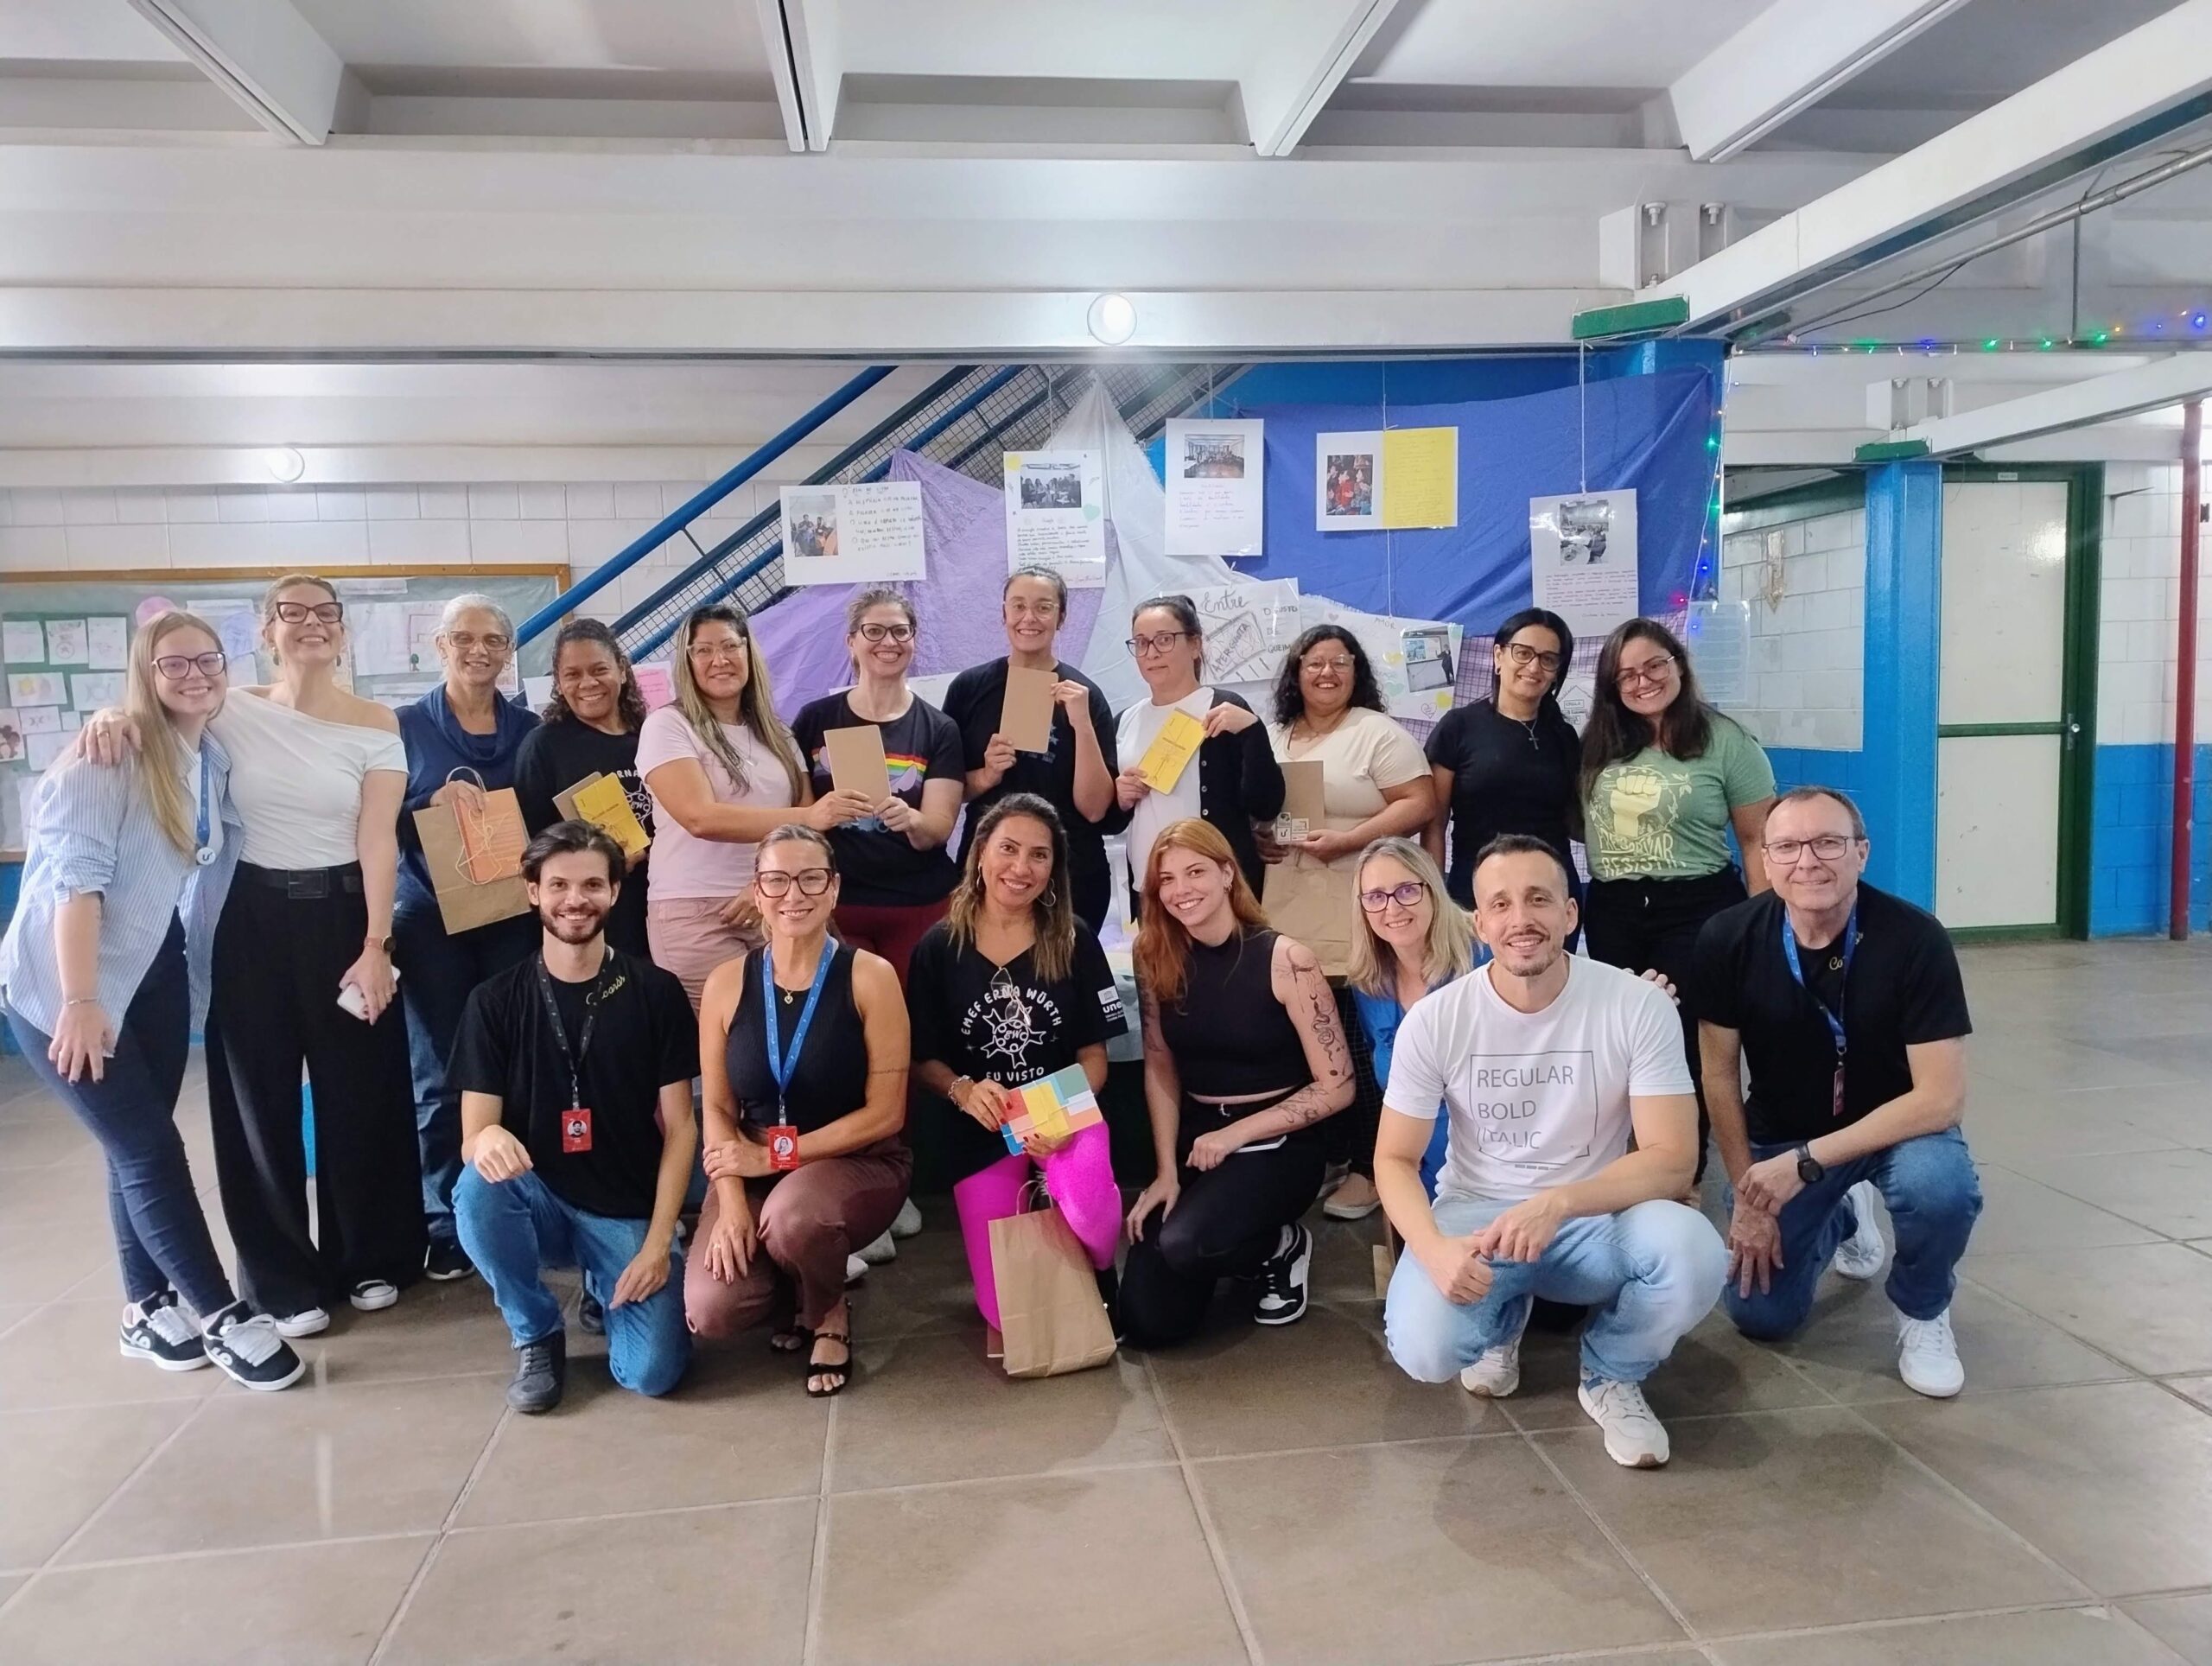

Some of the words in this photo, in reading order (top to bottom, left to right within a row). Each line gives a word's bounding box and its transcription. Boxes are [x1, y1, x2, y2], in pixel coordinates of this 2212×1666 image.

[961, 1001, 982, 1035] EMEF
[983, 985, 1020, 1004] ERNA
[1026, 988, 1063, 1027] WÜRTH
[1006, 1066, 1045, 1082] VISTO
[1477, 1065, 1574, 1088] REGULAR
[1478, 1100, 1536, 1120] BOLD
[1483, 1127, 1541, 1149] ITALIC
